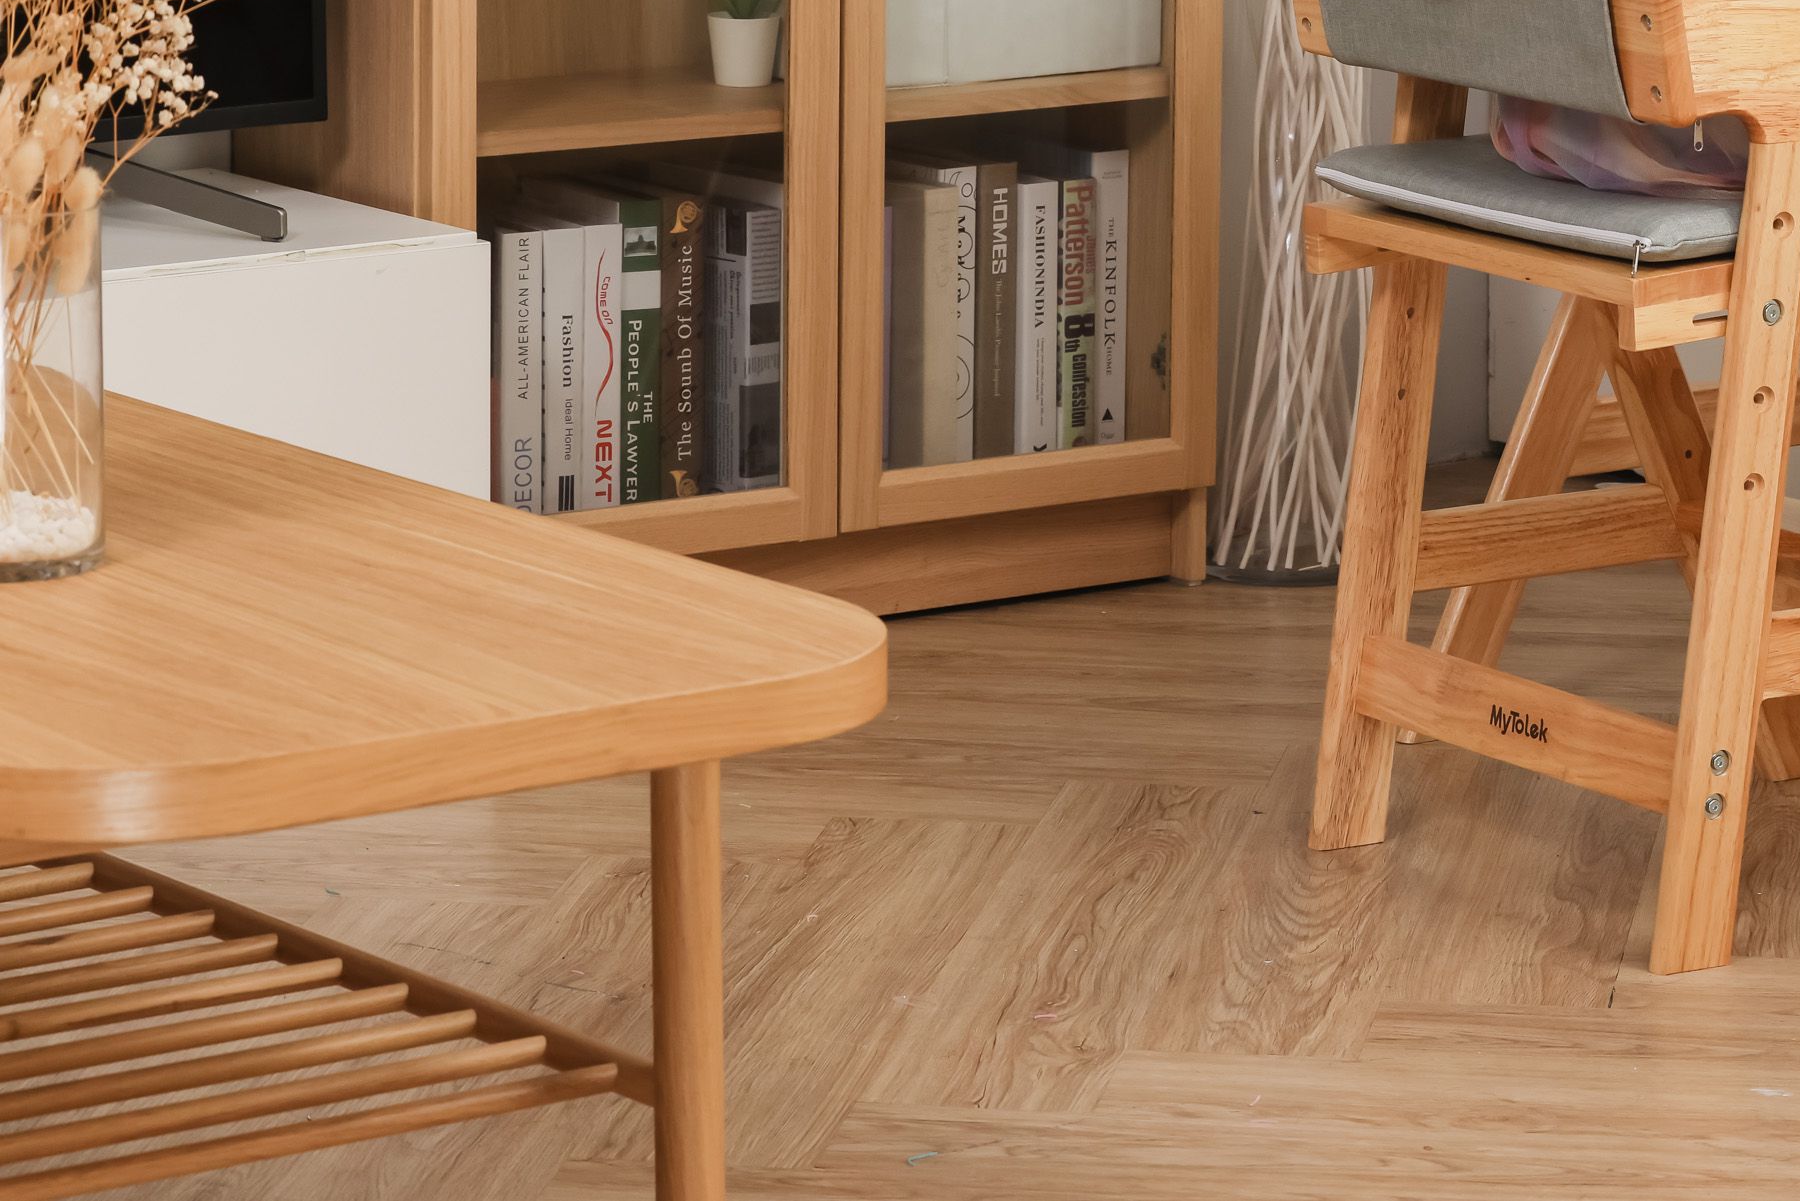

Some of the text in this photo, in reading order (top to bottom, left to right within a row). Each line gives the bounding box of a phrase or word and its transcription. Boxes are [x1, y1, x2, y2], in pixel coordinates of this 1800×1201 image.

[519, 237, 529, 280] FLAIR
[992, 188, 1008, 274] HOMES
[1065, 185, 1094, 306] Patterson
[678, 245, 692, 307] Music
[1104, 240, 1117, 346] KINFOLK
[518, 288, 529, 400] ALL-AMERICAN
[562, 315, 574, 387] Fashion
[678, 316, 692, 339] Of
[626, 320, 642, 500] PEOPLE'S LAWYER
[643, 392, 652, 423] THE
[1072, 354, 1090, 427] confession
[565, 399, 573, 460] Ideal Home
[595, 420, 612, 502] NEXT
[677, 421, 692, 461] The
[1490, 704, 1548, 743] MyTolek
